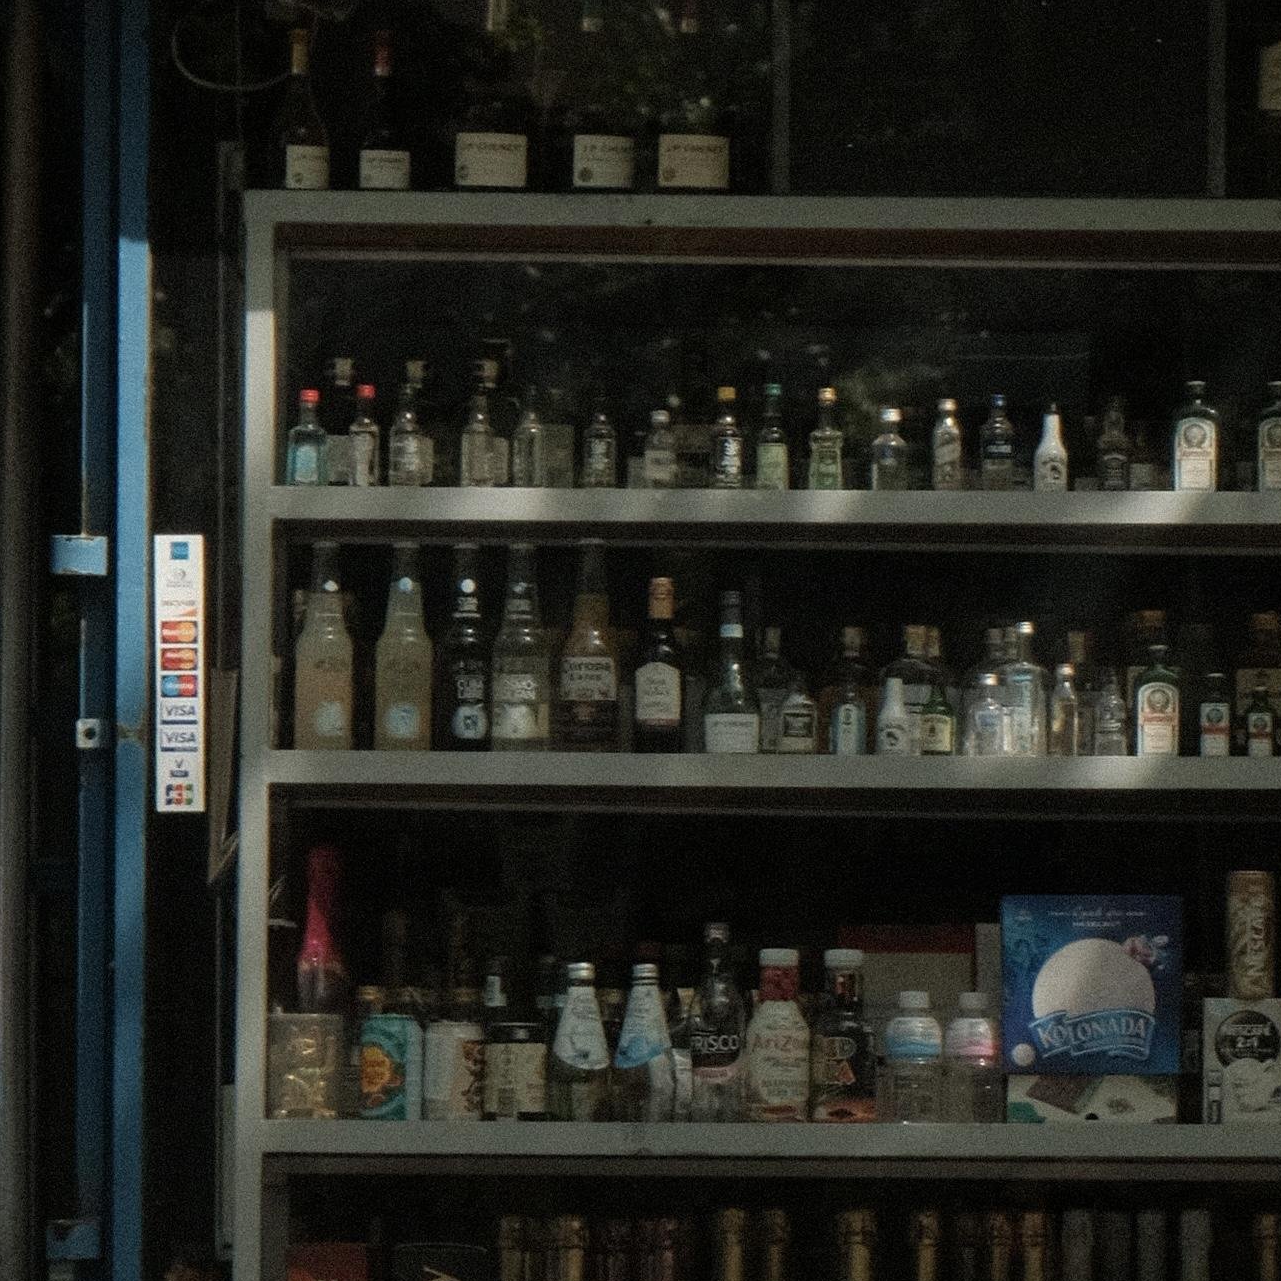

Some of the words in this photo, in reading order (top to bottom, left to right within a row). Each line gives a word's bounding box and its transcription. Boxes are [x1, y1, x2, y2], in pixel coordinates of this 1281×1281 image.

[165, 705, 196, 716] VISA
[164, 732, 196, 744] VISA
[1037, 1013, 1149, 1051] KOLONADA
